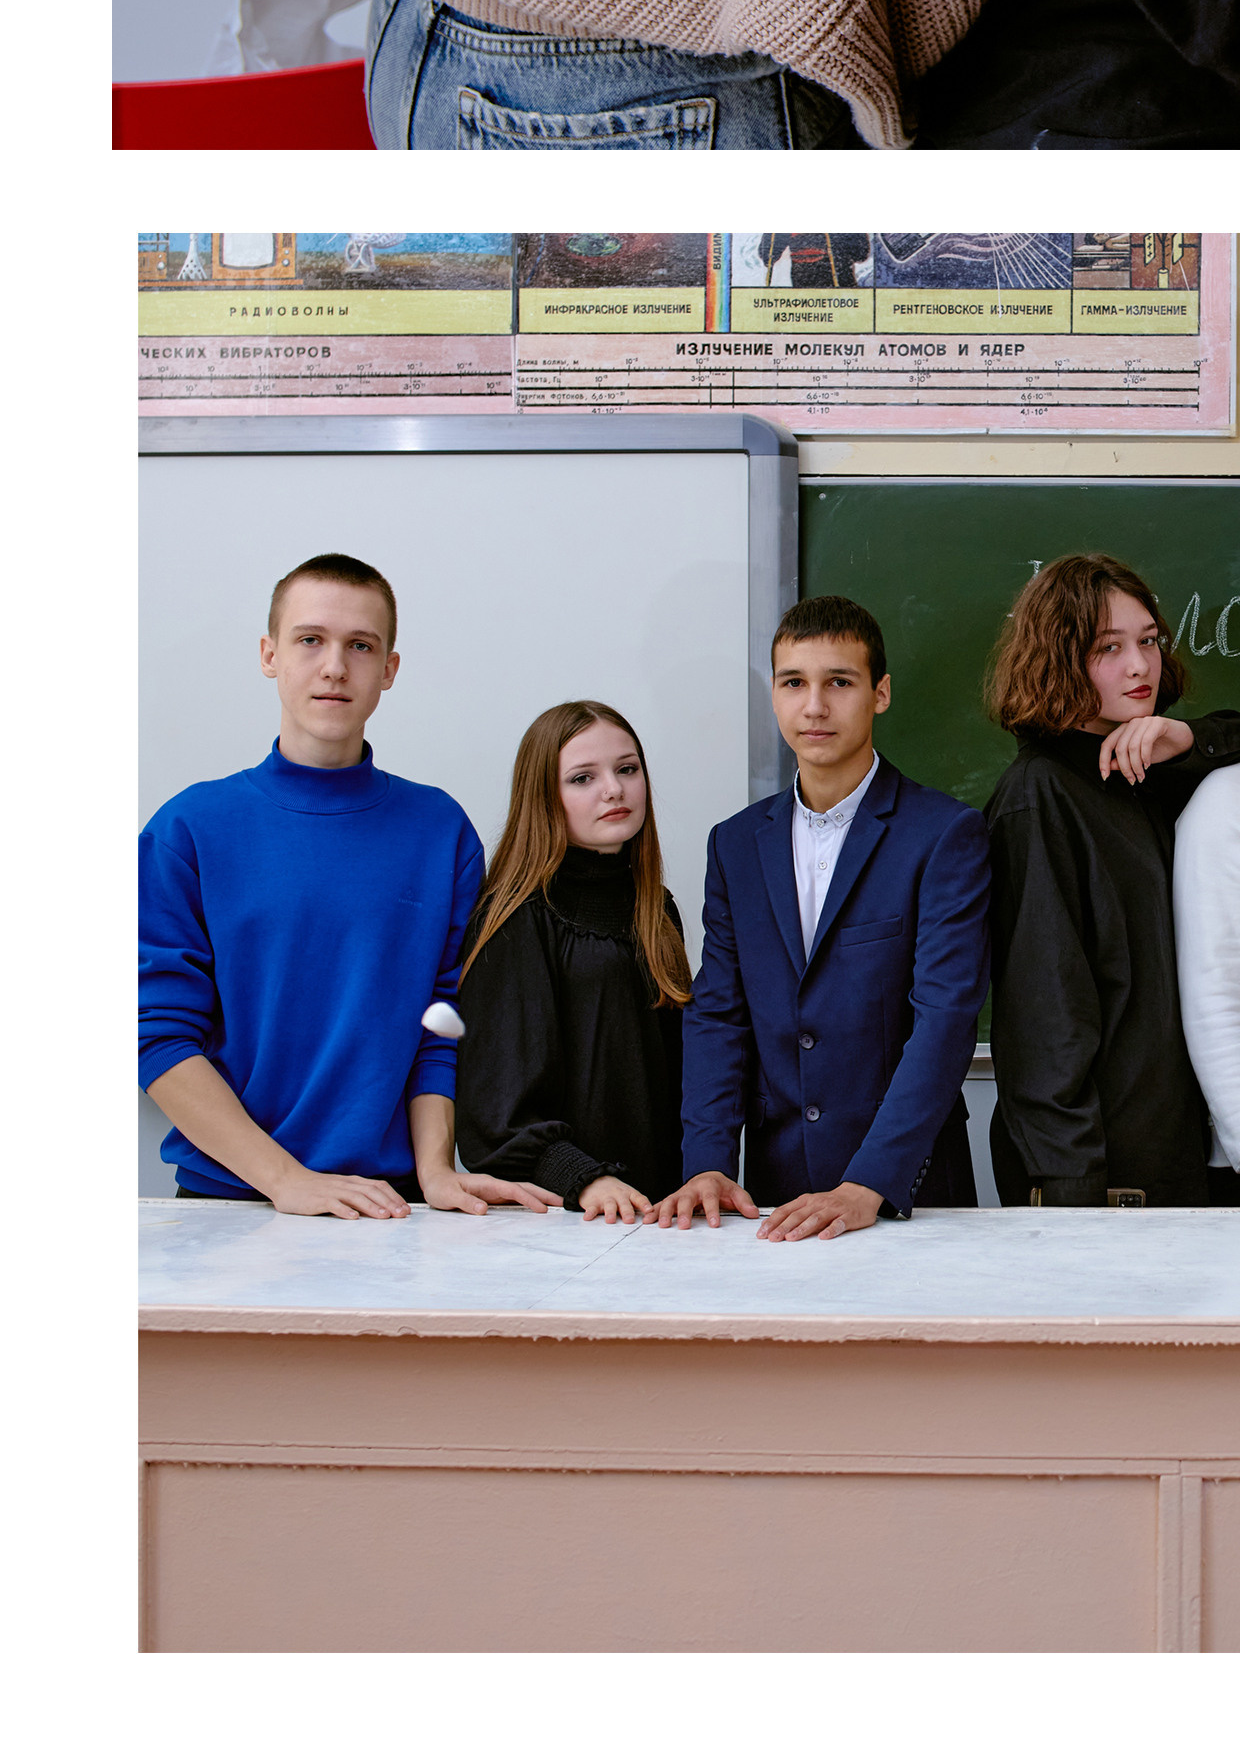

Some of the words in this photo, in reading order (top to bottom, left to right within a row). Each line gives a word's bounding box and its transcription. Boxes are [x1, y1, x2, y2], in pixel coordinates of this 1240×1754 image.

[753, 298, 859, 308] УЛЬТРАФИОЛЕТОВОЕ
[229, 306, 349, 317] РАДИОВОЛНЫ
[544, 304, 629, 315] ИНФРАКРАСНОЕ
[632, 303, 692, 314] ИЗЛУЧЕНИЕ
[893, 304, 984, 315] РЕНТГЕНОВСКОЕ
[990, 304, 1053, 315] ИЗЛУЧЕНИЕ
[1080, 304, 1188, 316] ГАММА-ИЗЛУЧЕНИЕ
[773, 312, 834, 323] ИЗЛУЧЕНИЕ
[219, 346, 332, 359] ВИБРАТОРОВ
[676, 343, 773, 356] ИЗЛУЧЕНИЕ
[784, 343, 865, 356] МОЛЕКУЛ
[878, 343, 947, 357] АТОМОВ
[958, 344, 969, 357] И
[980, 344, 1026, 357] ЯДЕР
